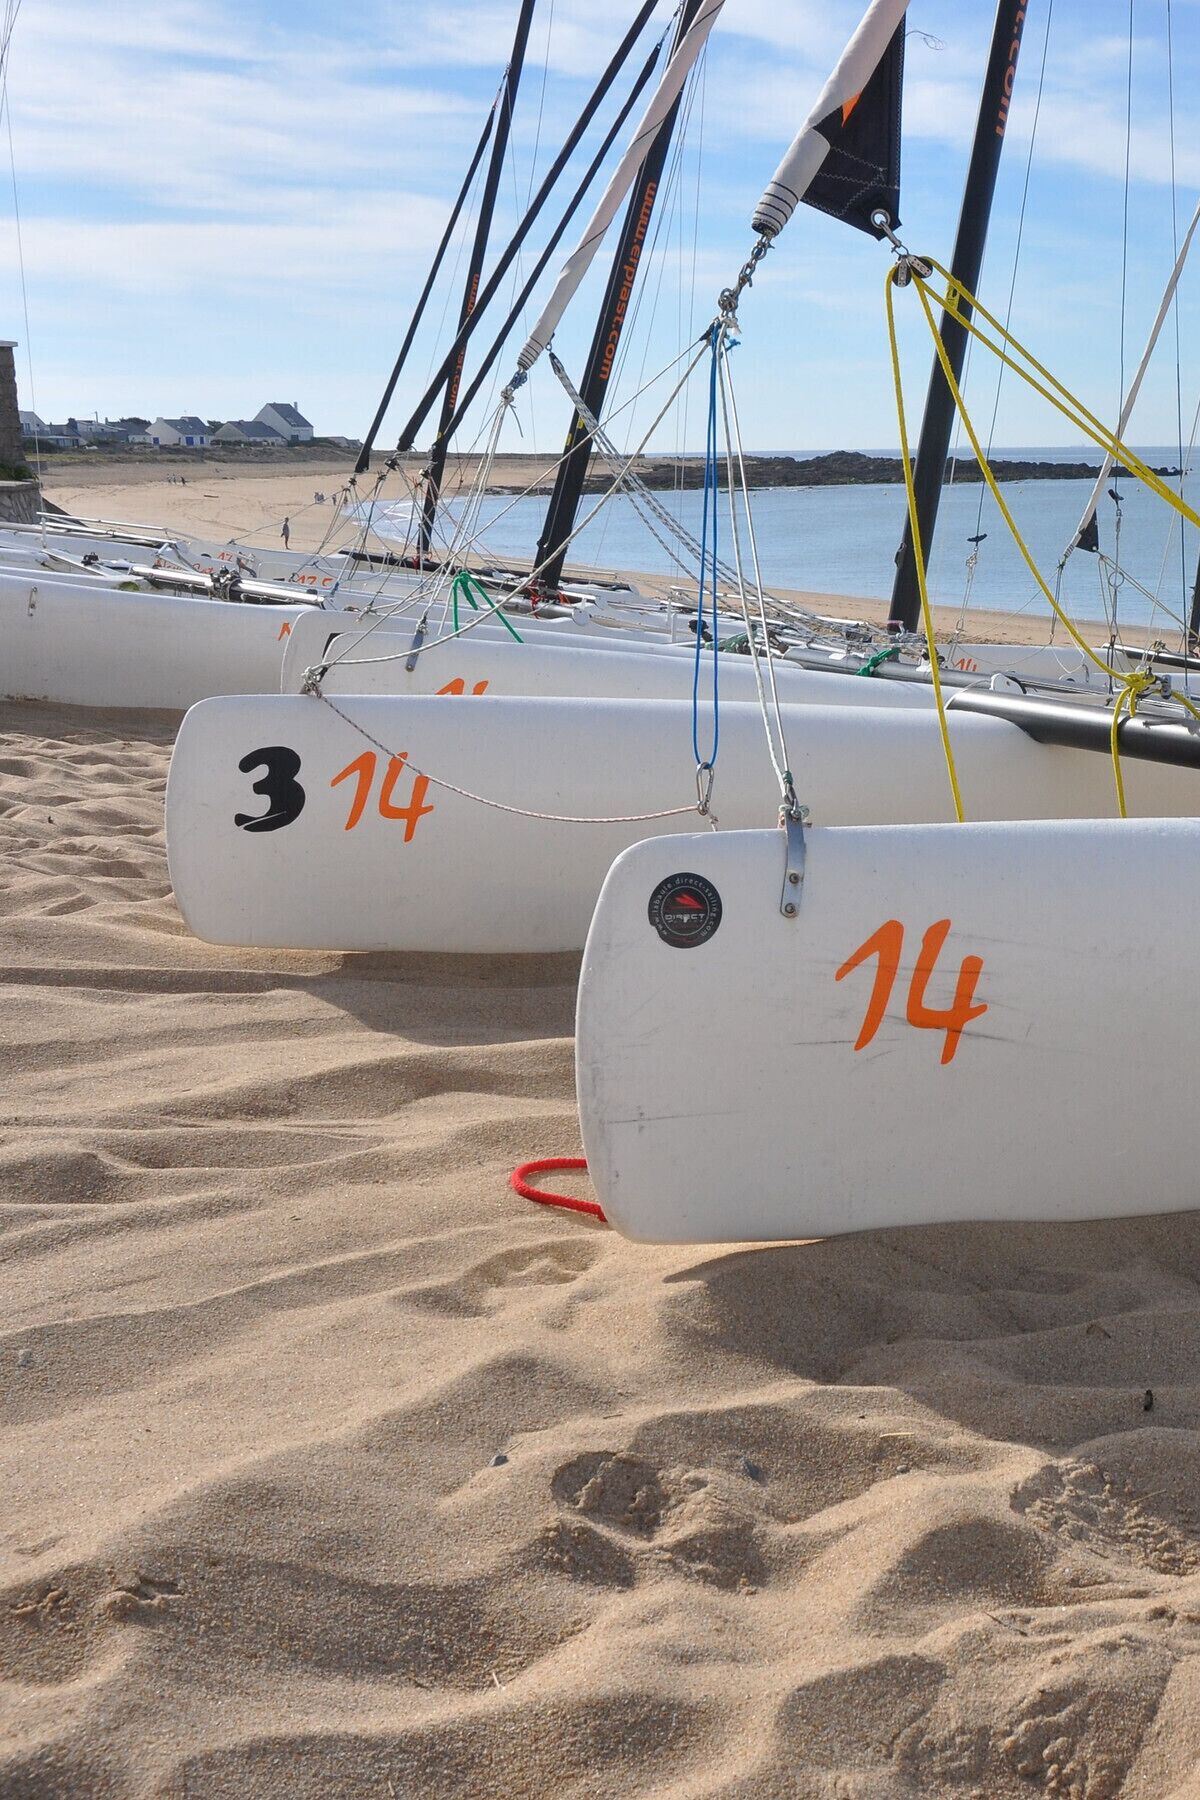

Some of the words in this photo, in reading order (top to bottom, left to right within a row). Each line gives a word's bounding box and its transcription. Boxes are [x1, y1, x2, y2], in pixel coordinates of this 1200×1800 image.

[600, 181, 657, 380] www.erplast.com
[234, 746, 306, 833] 3
[331, 751, 434, 843] 14
[835, 919, 988, 1065] 14
